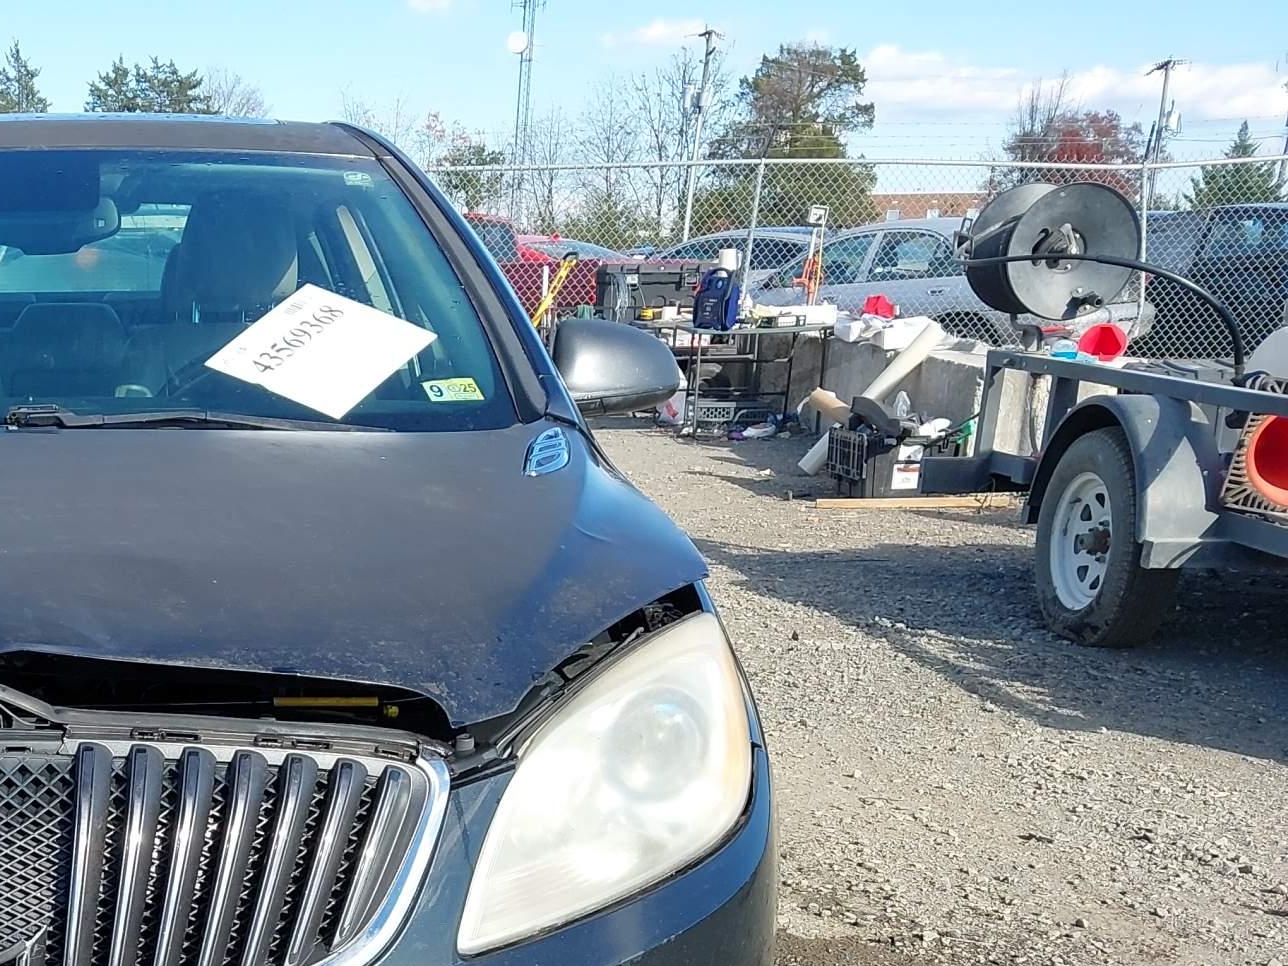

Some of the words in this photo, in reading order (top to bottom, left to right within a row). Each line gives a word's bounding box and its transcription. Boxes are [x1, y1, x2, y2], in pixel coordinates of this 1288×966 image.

[252, 305, 344, 373] 43569368
[429, 384, 444, 398] 9
[459, 383, 477, 393] 25
